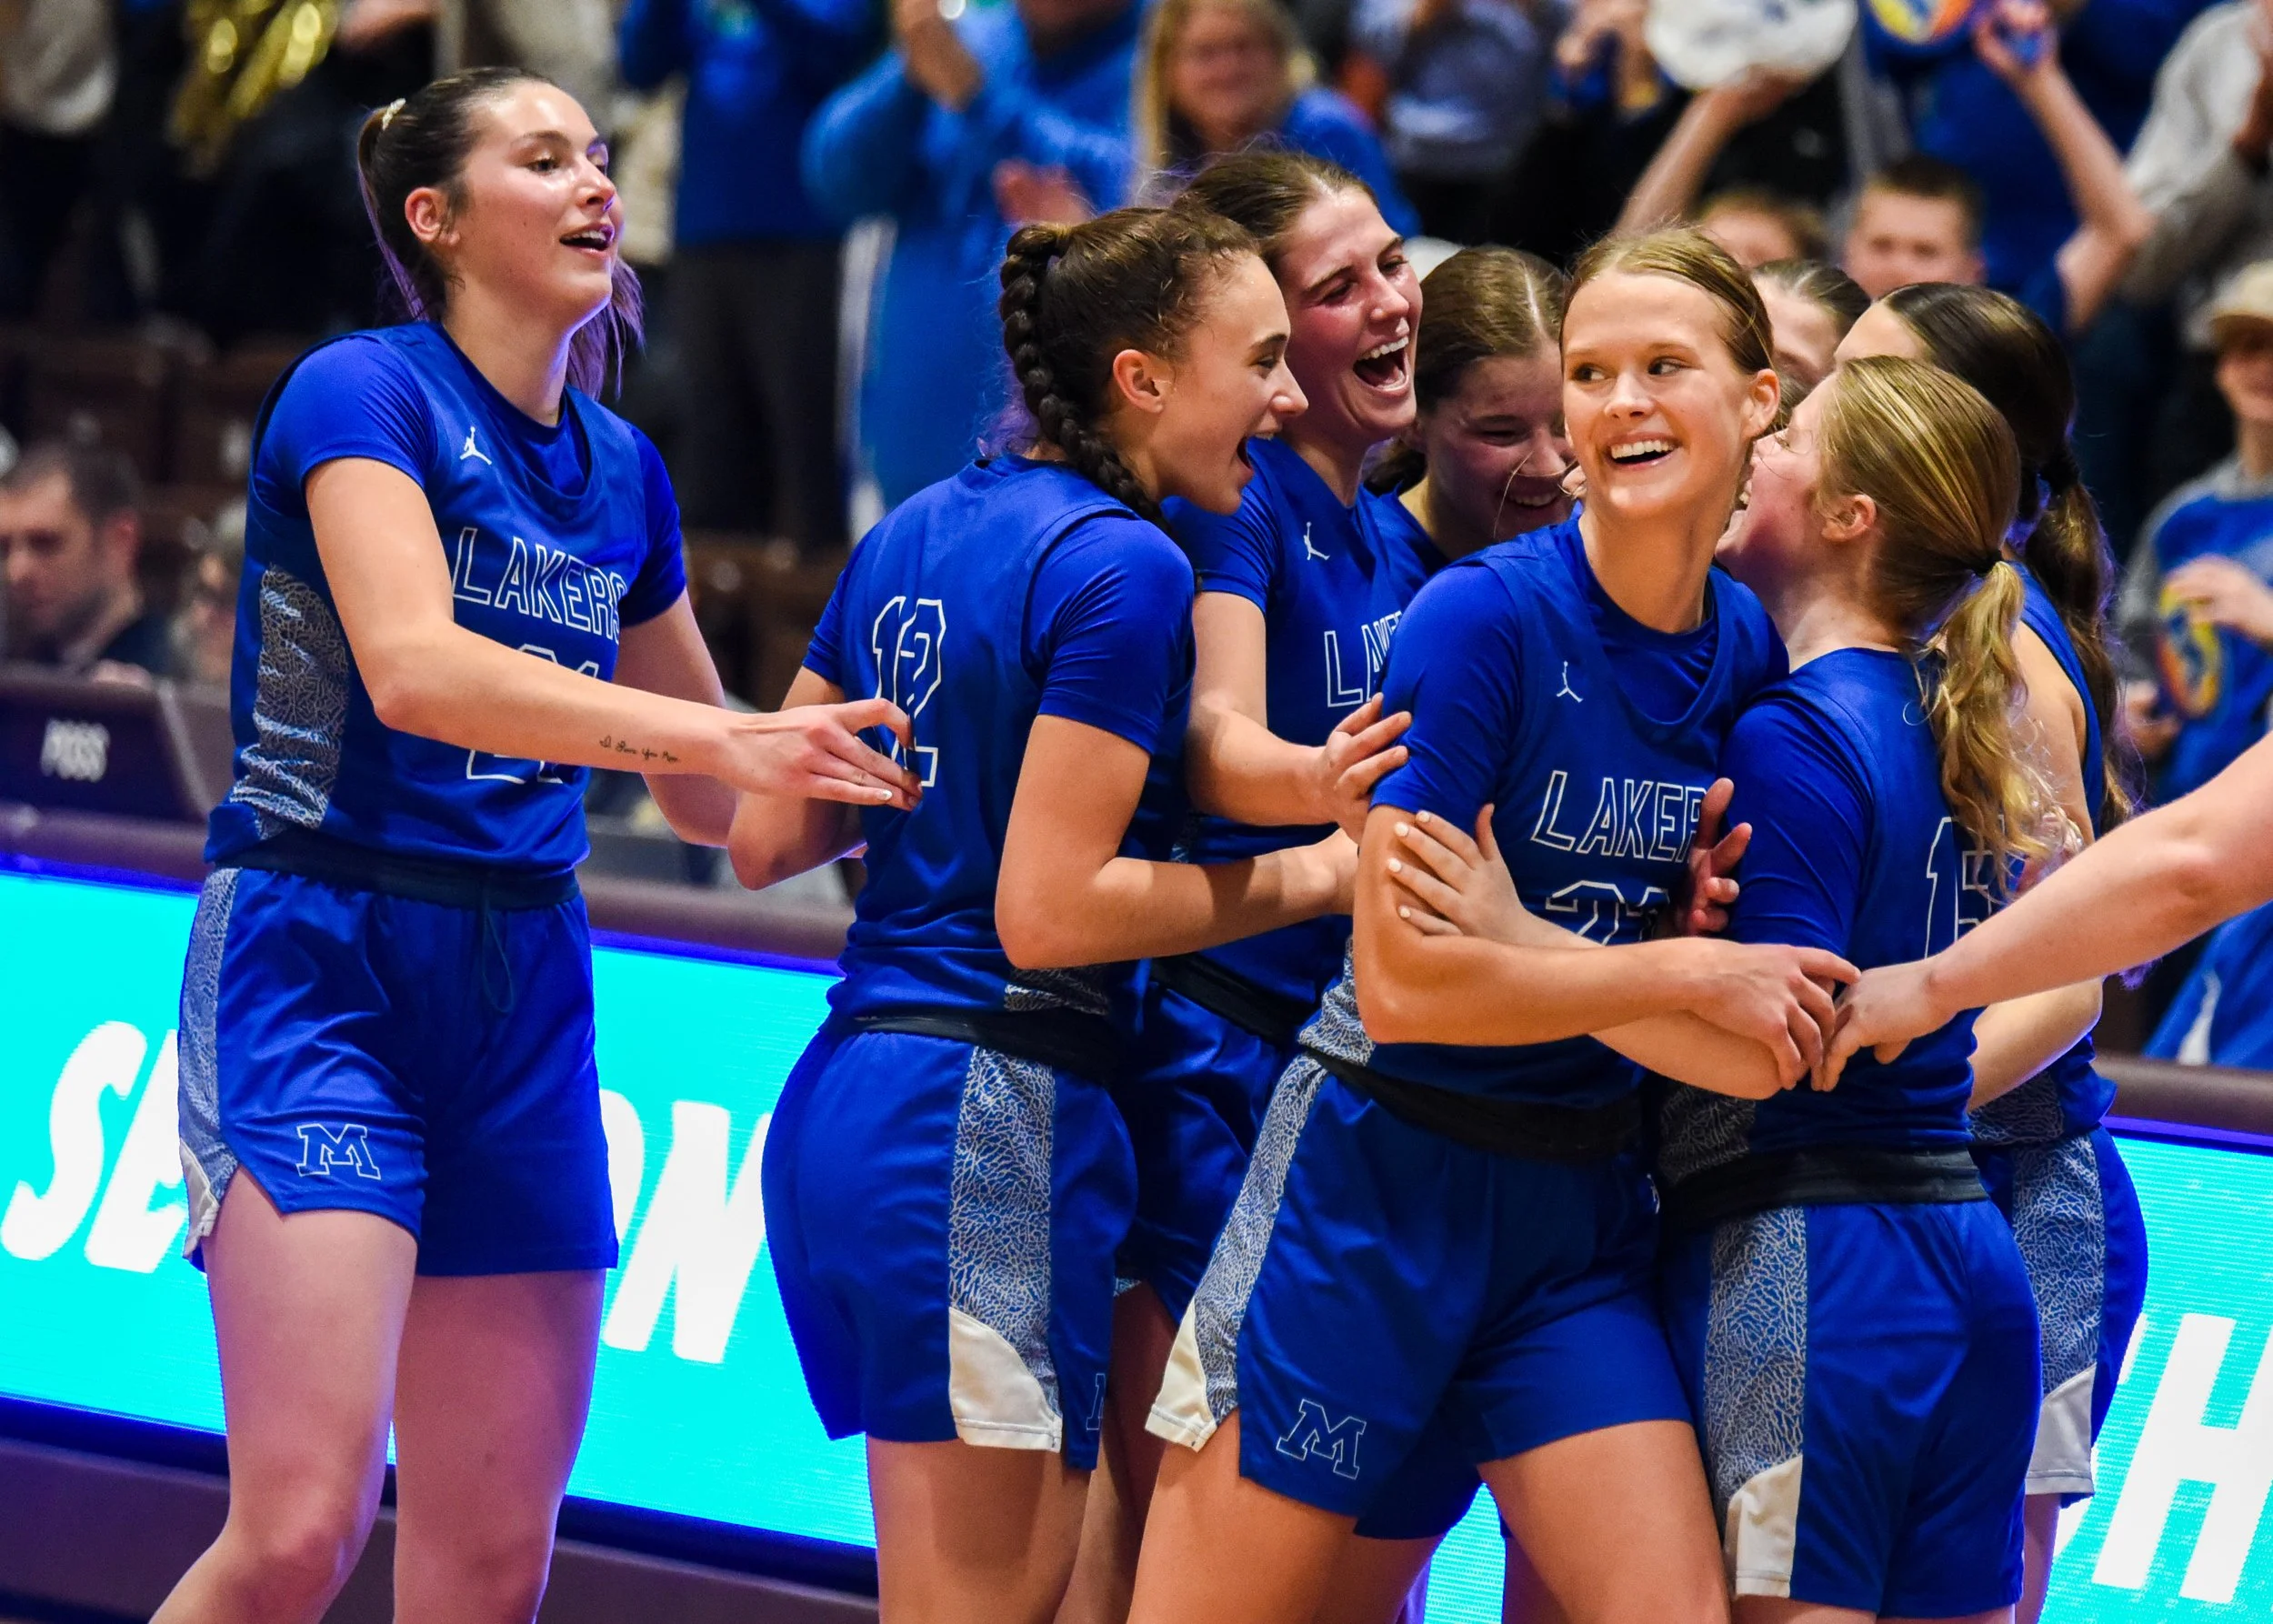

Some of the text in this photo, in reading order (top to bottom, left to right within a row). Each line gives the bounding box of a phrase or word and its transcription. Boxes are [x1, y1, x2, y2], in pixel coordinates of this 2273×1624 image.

[872, 596, 946, 787] 12
[295, 1123, 381, 1180] M
[1276, 1398, 1367, 1480] M
